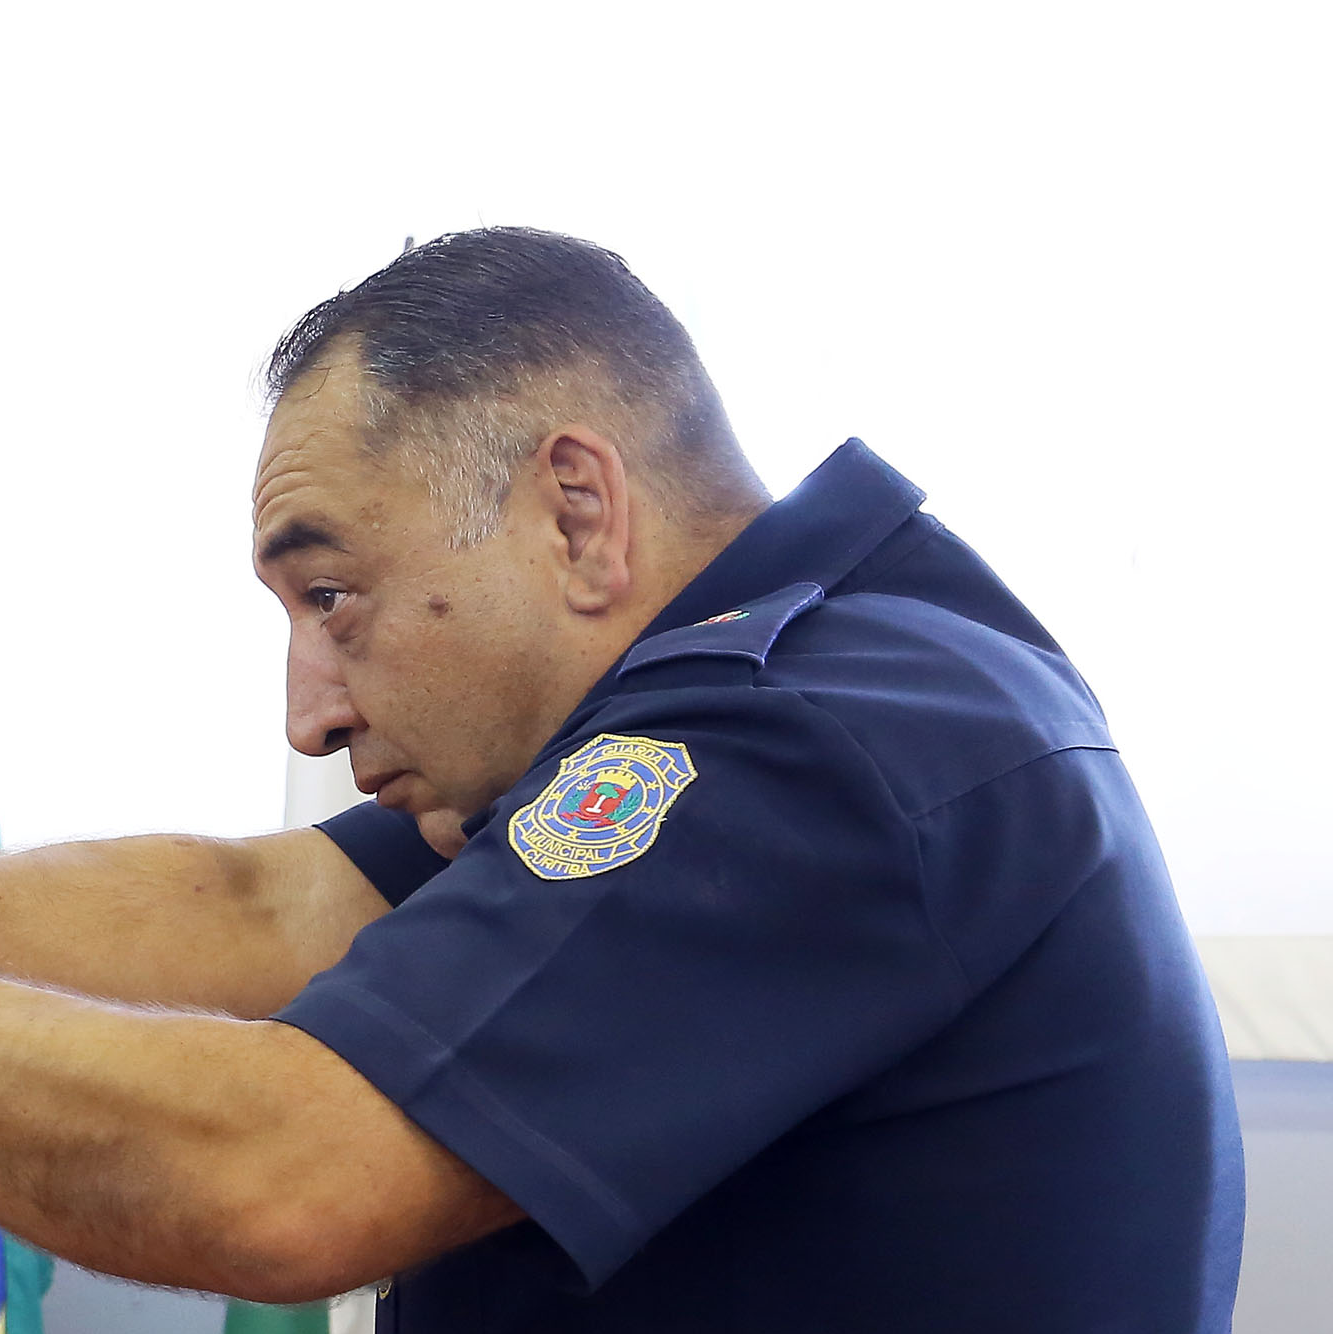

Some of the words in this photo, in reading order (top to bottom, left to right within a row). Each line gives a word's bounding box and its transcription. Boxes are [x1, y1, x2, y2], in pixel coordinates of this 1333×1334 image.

[601, 743, 664, 764] GUARDA
[527, 831, 605, 862] MUNICIPAL
[524, 849, 591, 876] CURITIBA
